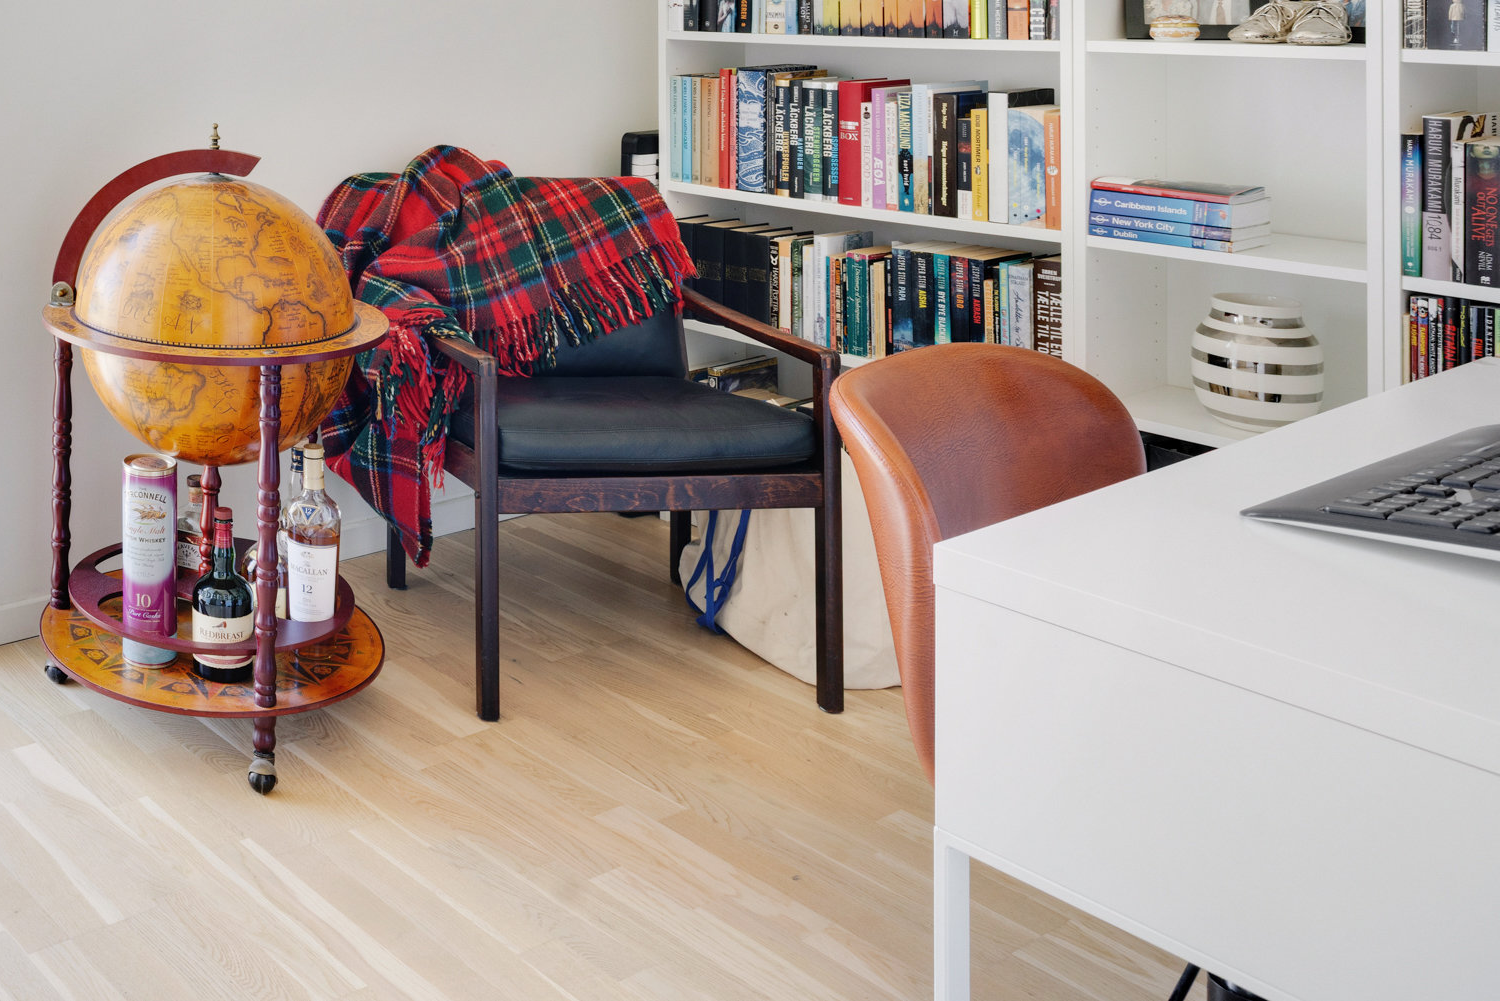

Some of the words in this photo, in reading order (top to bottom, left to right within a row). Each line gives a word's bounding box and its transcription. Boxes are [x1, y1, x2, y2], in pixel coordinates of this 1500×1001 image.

[1030, 8, 1045, 38] CELL
[899, 94, 910, 109] LIZA
[775, 104, 785, 151] LÄCKBERG
[790, 103, 800, 146] LÄCKBERG
[804, 106, 815, 155] LÄCKBERG
[823, 108, 834, 157] LÄCKBERG
[900, 111, 910, 149] MARKLUND
[840, 132, 859, 141] BOX
[1428, 120, 1442, 156] HARUKI
[874, 157, 885, 186] ÆØÅ
[1405, 160, 1414, 203] MURAKAMI
[1427, 159, 1443, 212] MURAKAMI
[1453, 177, 1462, 206] Murakami
[1485, 187, 1497, 204] NO
[1114, 200, 1156, 212] Caribbean
[1158, 205, 1187, 216] Islands
[1476, 192, 1485, 210] OUT
[1112, 216, 1132, 226] New
[1134, 219, 1155, 230] York
[1156, 222, 1175, 232] City
[1425, 215, 1442, 240] 1Q84
[1471, 207, 1485, 241] ALIVE
[1485, 210, 1498, 228] ONE
[1113, 229, 1138, 239] Dublin
[1485, 229, 1494, 247] GETS
[918, 258, 926, 274] JESPER
[955, 262, 963, 278] JESPER
[1478, 251, 1486, 271] NEVILL
[918, 275, 926, 288] STEIN
[956, 279, 964, 293] STEIN
[972, 283, 980, 297] STEIN
[973, 299, 981, 324] AKRASH
[1037, 290, 1049, 322] TÆLLE
[1037, 325, 1049, 338] TIL
[1037, 342, 1049, 353] TO
[302, 584, 313, 594] 12
[136, 593, 152, 609] 10
[200, 627, 245, 641] REDBREAST
